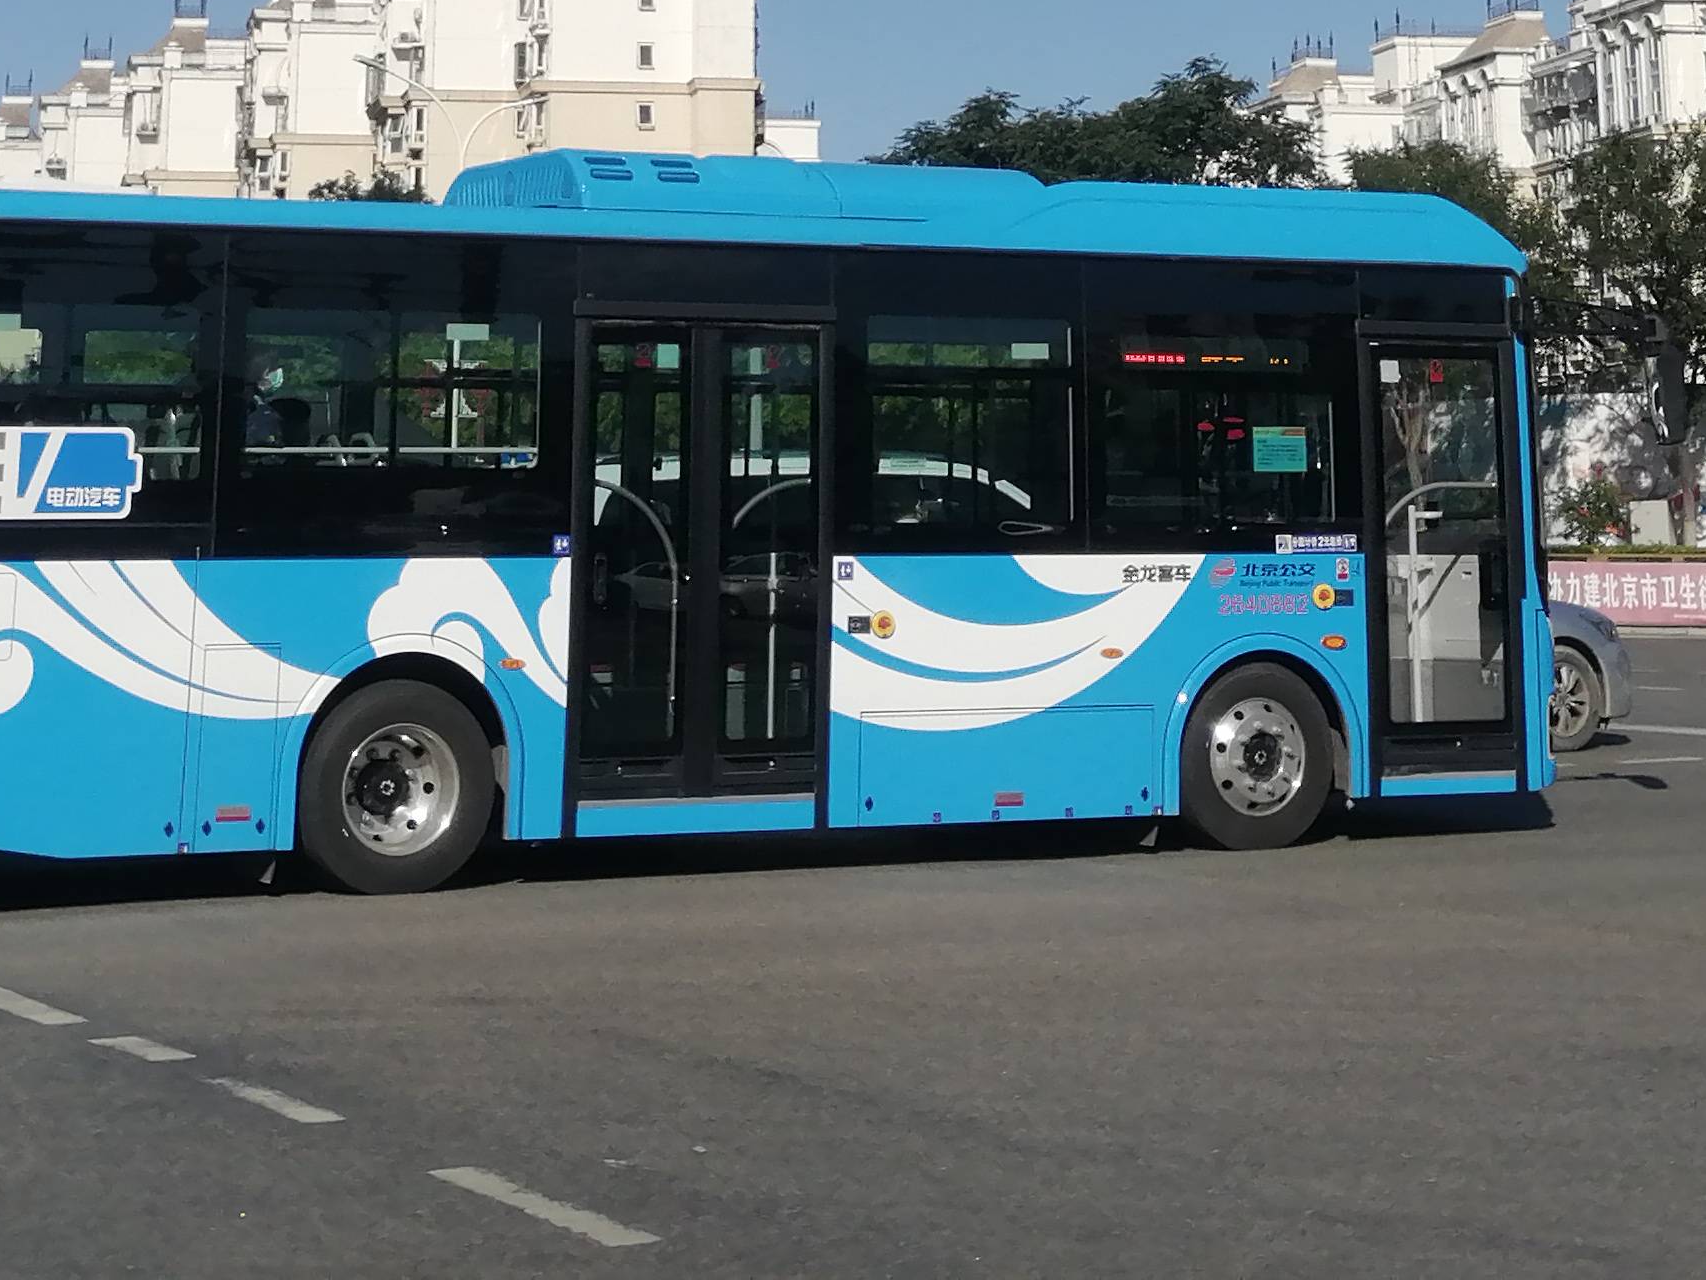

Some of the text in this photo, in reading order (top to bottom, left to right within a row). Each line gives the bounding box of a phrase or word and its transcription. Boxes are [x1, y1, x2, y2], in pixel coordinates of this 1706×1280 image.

[46, 487, 121, 507] 电动汽车
[1122, 564, 1191, 584] 金龙客车
[1241, 562, 1316, 578] 北京公交
